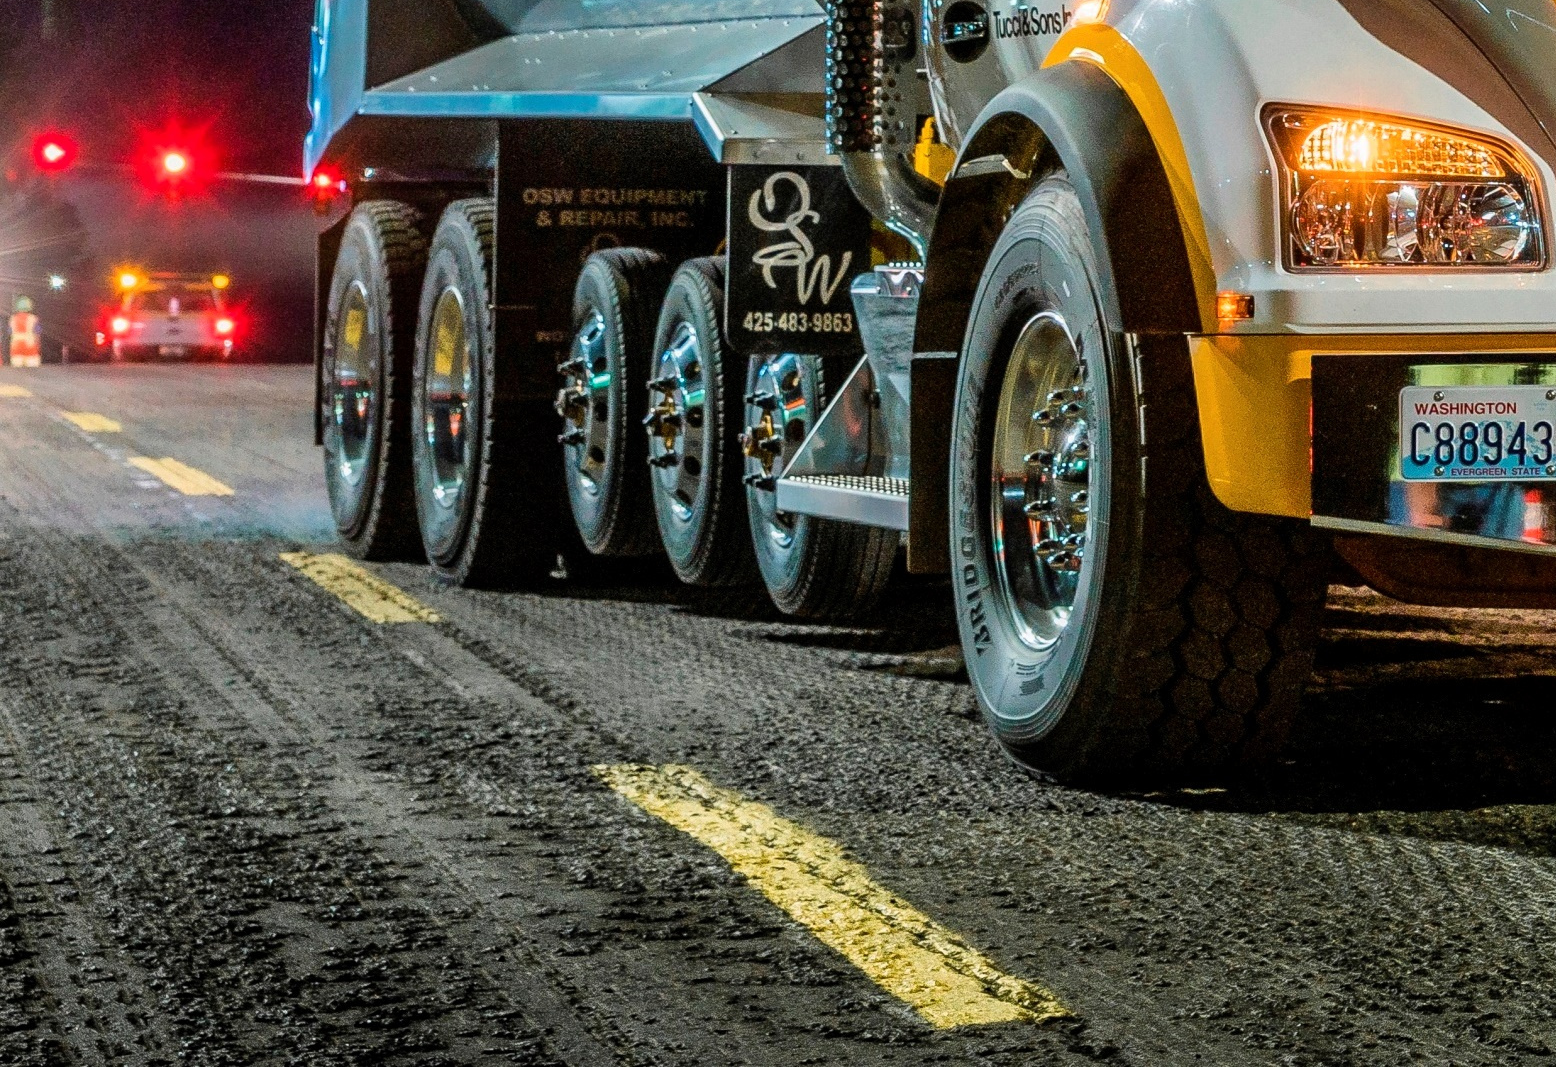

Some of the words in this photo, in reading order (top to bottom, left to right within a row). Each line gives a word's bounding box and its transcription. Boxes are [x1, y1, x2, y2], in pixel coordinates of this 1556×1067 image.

[522, 188, 573, 205] OSW
[580, 188, 707, 206] EQUIPMENT
[536, 210, 552, 227] &
[1414, 402, 1517, 415] WASHINGTON
[1451, 467, 1507, 476] EVERGREEN
[1511, 467, 1540, 475] STATE
